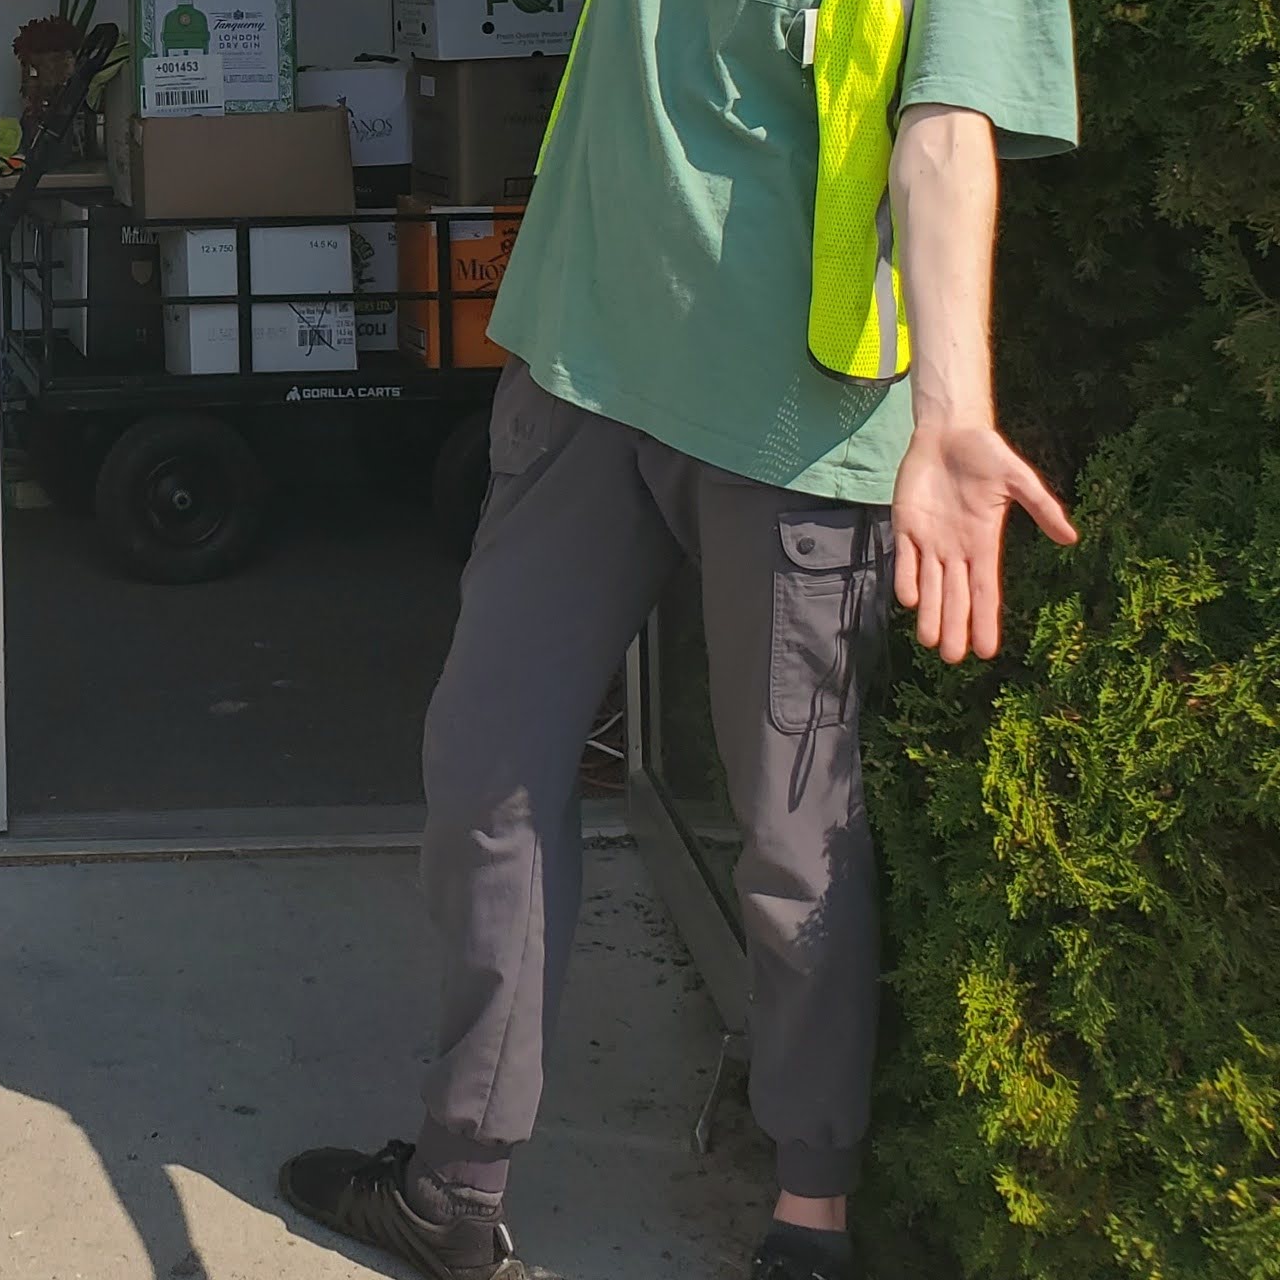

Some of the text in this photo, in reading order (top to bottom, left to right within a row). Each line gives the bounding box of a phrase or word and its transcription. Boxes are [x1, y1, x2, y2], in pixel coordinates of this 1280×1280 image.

[212, 18, 265, 33] Tanqueray
[218, 34, 260, 42] LONDON
[219, 41, 261, 50] DRY GIN
[155, 61, 199, 73] +001453
[201, 245, 211, 253] 12
[219, 244, 234, 253] 750
[309, 239, 338, 249] 14.5 Kg
[302, 386, 401, 399] GORILLA CARTS
